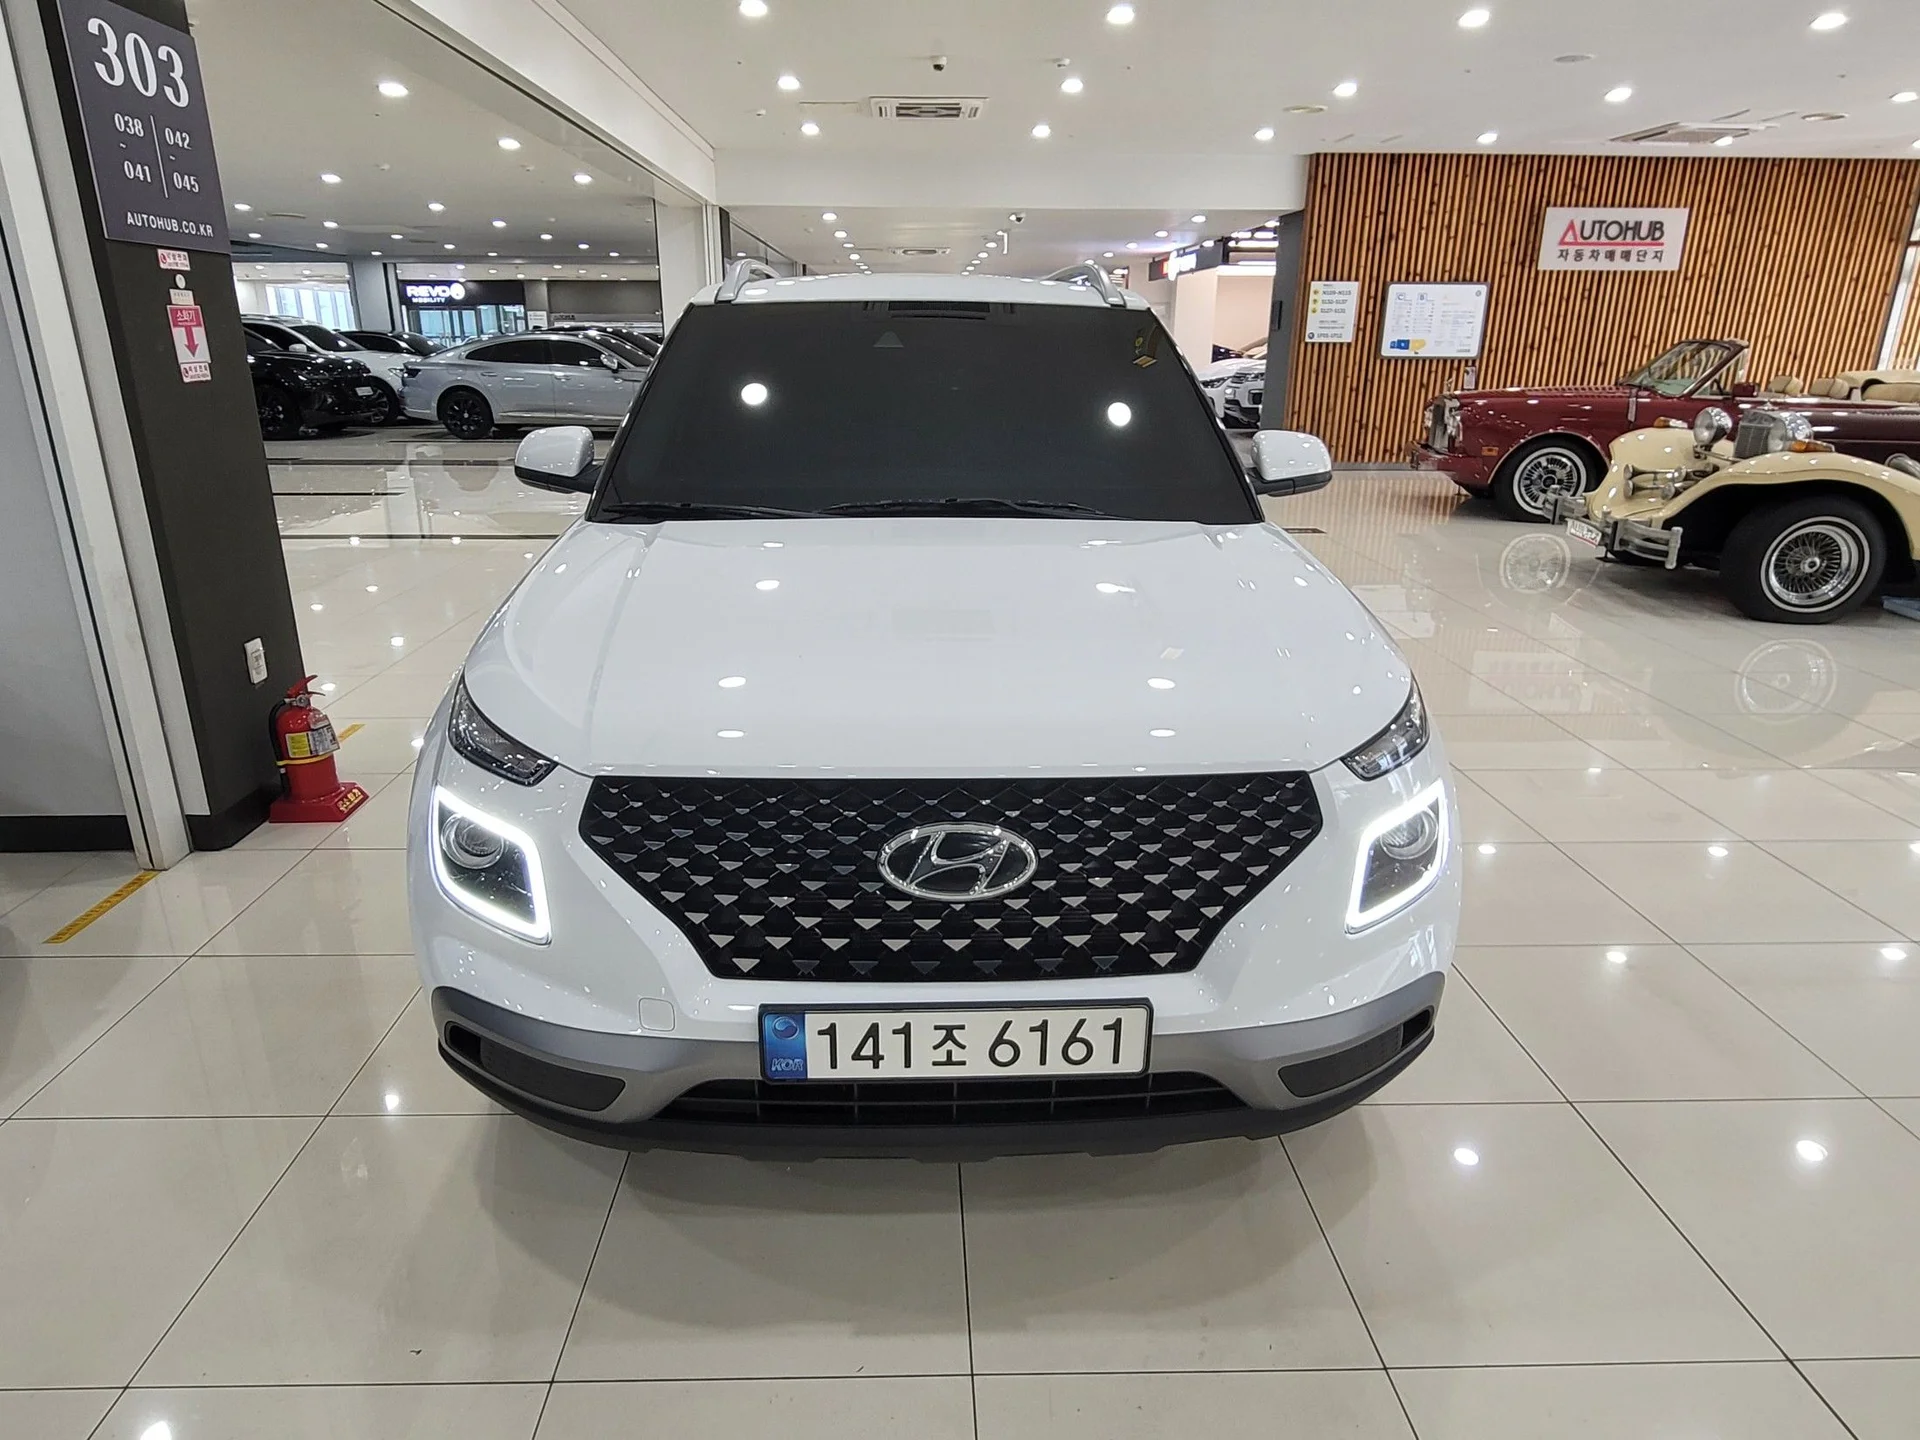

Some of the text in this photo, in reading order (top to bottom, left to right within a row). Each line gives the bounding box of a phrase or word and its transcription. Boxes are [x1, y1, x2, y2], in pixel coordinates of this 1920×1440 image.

[87, 17, 190, 108] 303
[114, 113, 145, 137] 038
[165, 127, 192, 150] 042
[124, 161, 152, 183] 041
[173, 172, 199, 193] 045
[126, 211, 214, 238] AUTOHUB.CO.KR
[1558, 219, 1665, 246] AUTOHUB
[1557, 248, 1664, 263] 자동차매매단지
[406, 285, 451, 297] REVO
[176, 310, 196, 322] 소화기
[817, 1017, 1123, 1070] 141조 6161
[771, 1058, 804, 1071] KOR
